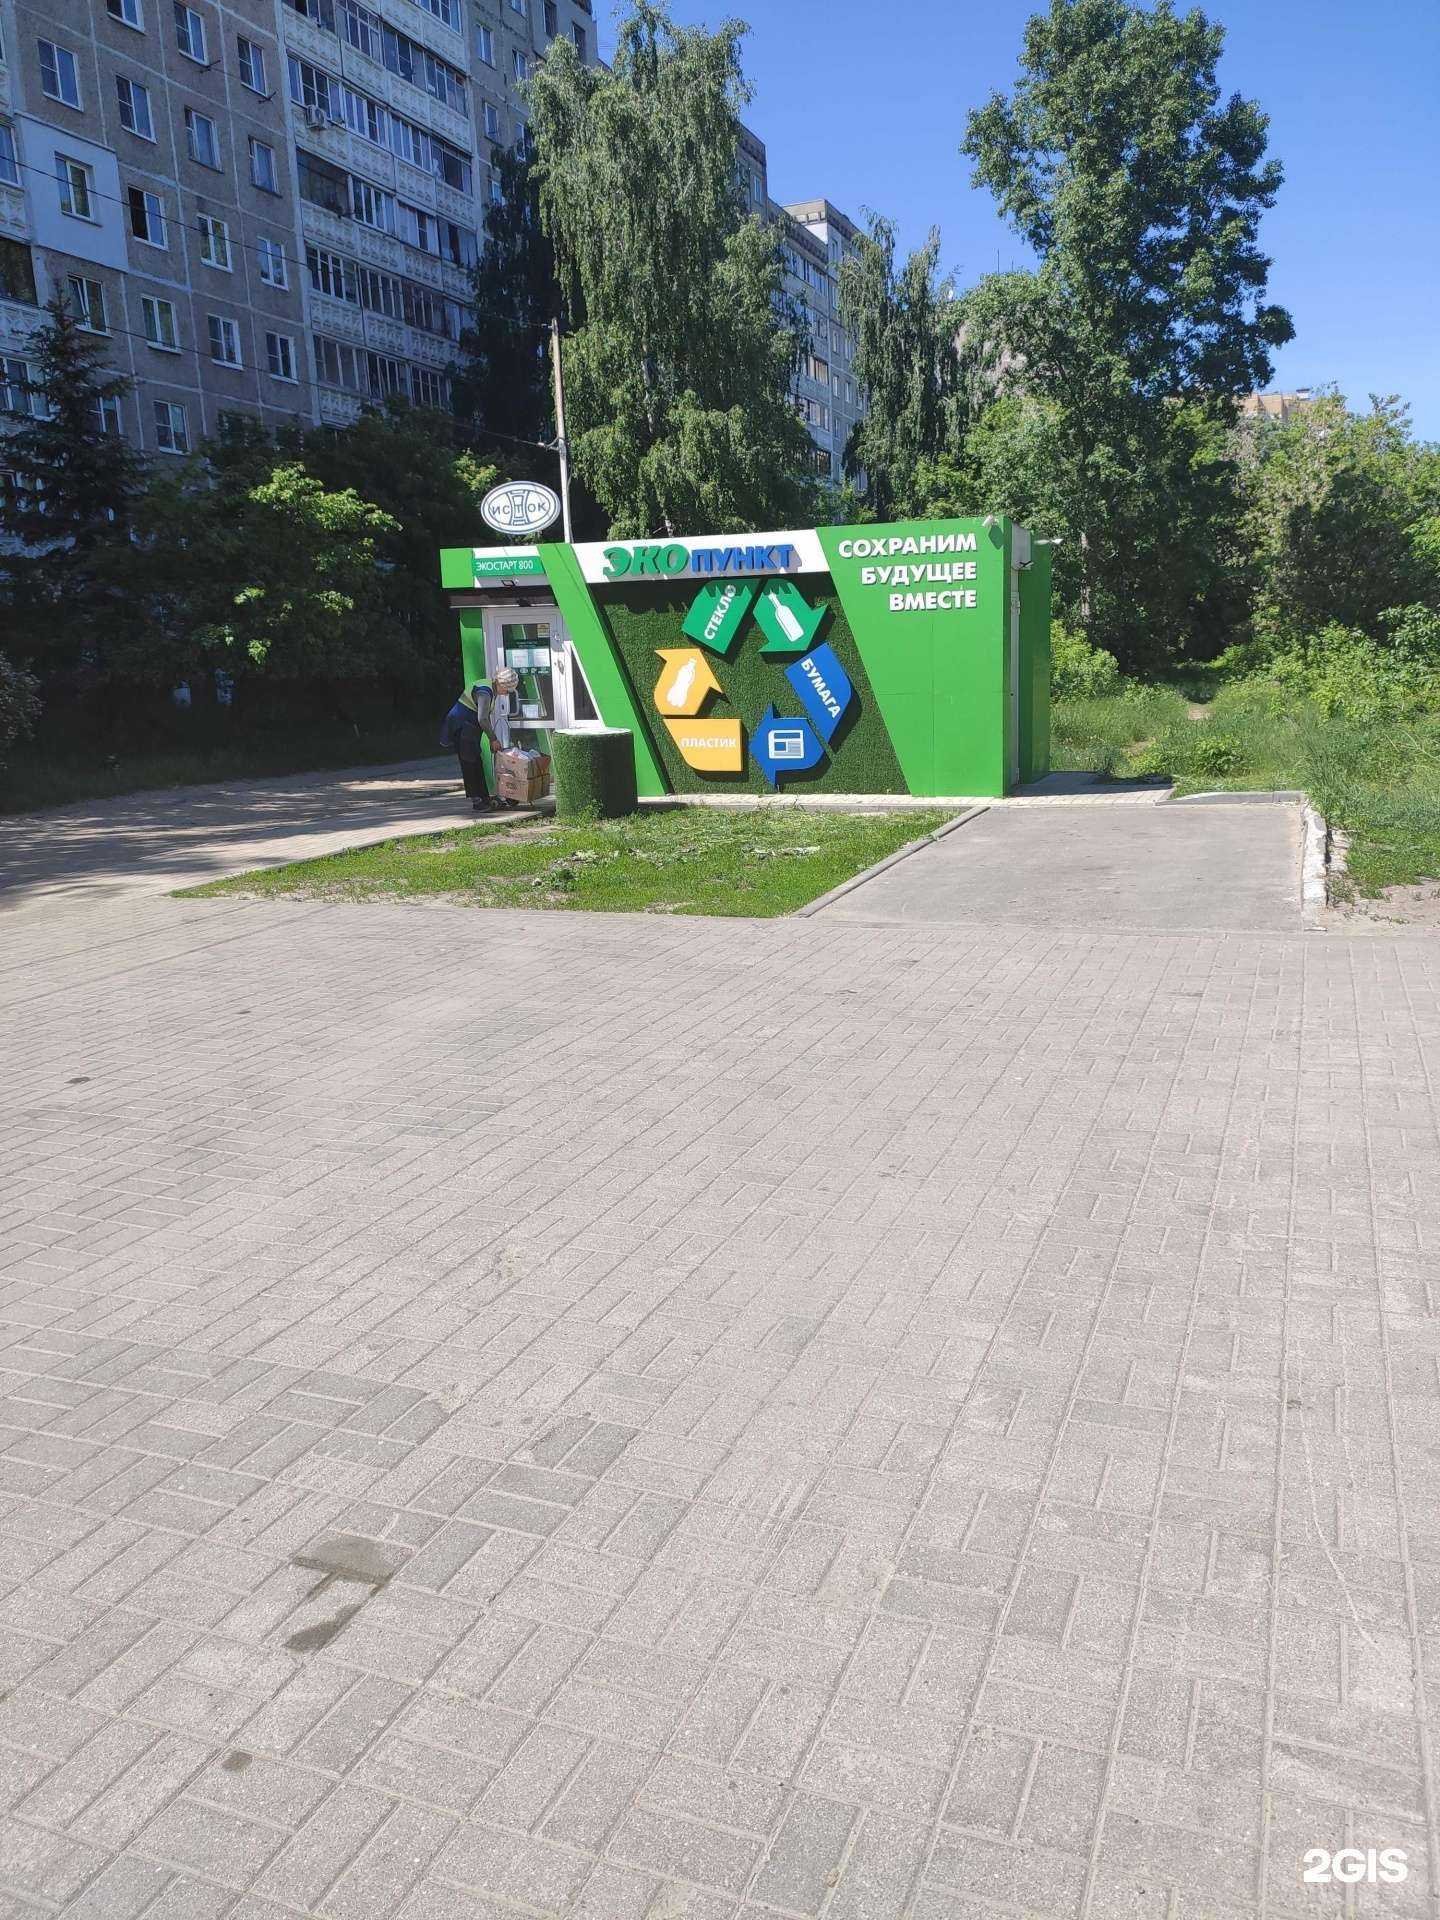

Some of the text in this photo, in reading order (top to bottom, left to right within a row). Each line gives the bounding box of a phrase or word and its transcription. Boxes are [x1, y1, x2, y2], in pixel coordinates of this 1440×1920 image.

[491, 501, 548, 516] ИСТОК
[838, 533, 977, 558] СОХРАНИМ
[475, 559, 534, 572] ЭКОСТАРТ 800
[602, 543, 796, 578] ЭКОПУНКТ
[861, 562, 977, 586] БУДУЩЕЕ
[703, 584, 737, 640] СТЕКЛО
[889, 590, 977, 612] ВМЕСТЕ
[800, 658, 841, 718] БУМАГА
[680, 737, 737, 749] ПЛАСТИК
